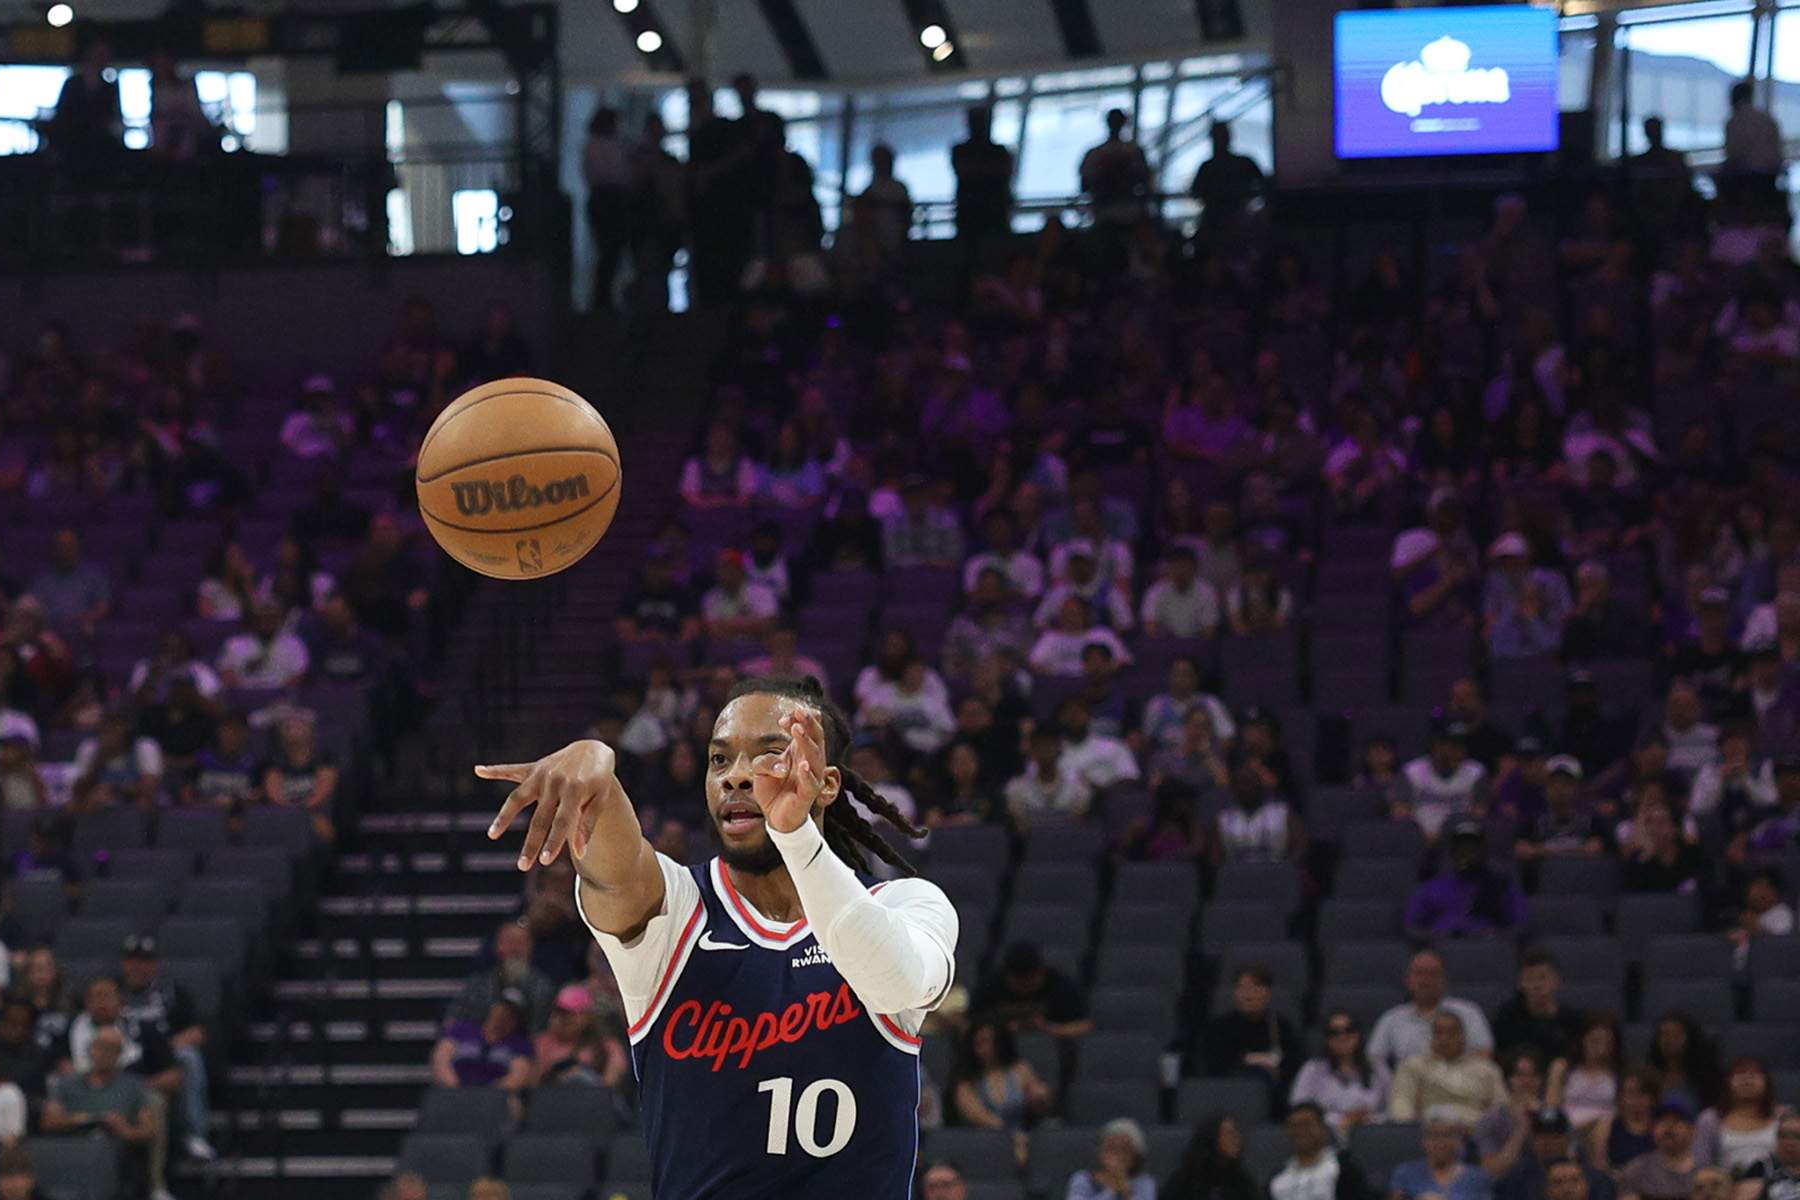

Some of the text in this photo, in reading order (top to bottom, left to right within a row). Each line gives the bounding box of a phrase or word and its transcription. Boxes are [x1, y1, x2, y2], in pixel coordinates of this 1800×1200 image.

[450, 472, 591, 516] Wilson
[791, 953, 832, 968] RWAN
[803, 945, 825, 957] VIS
[663, 982, 860, 1072] Clippers
[757, 1076, 858, 1159] 10
